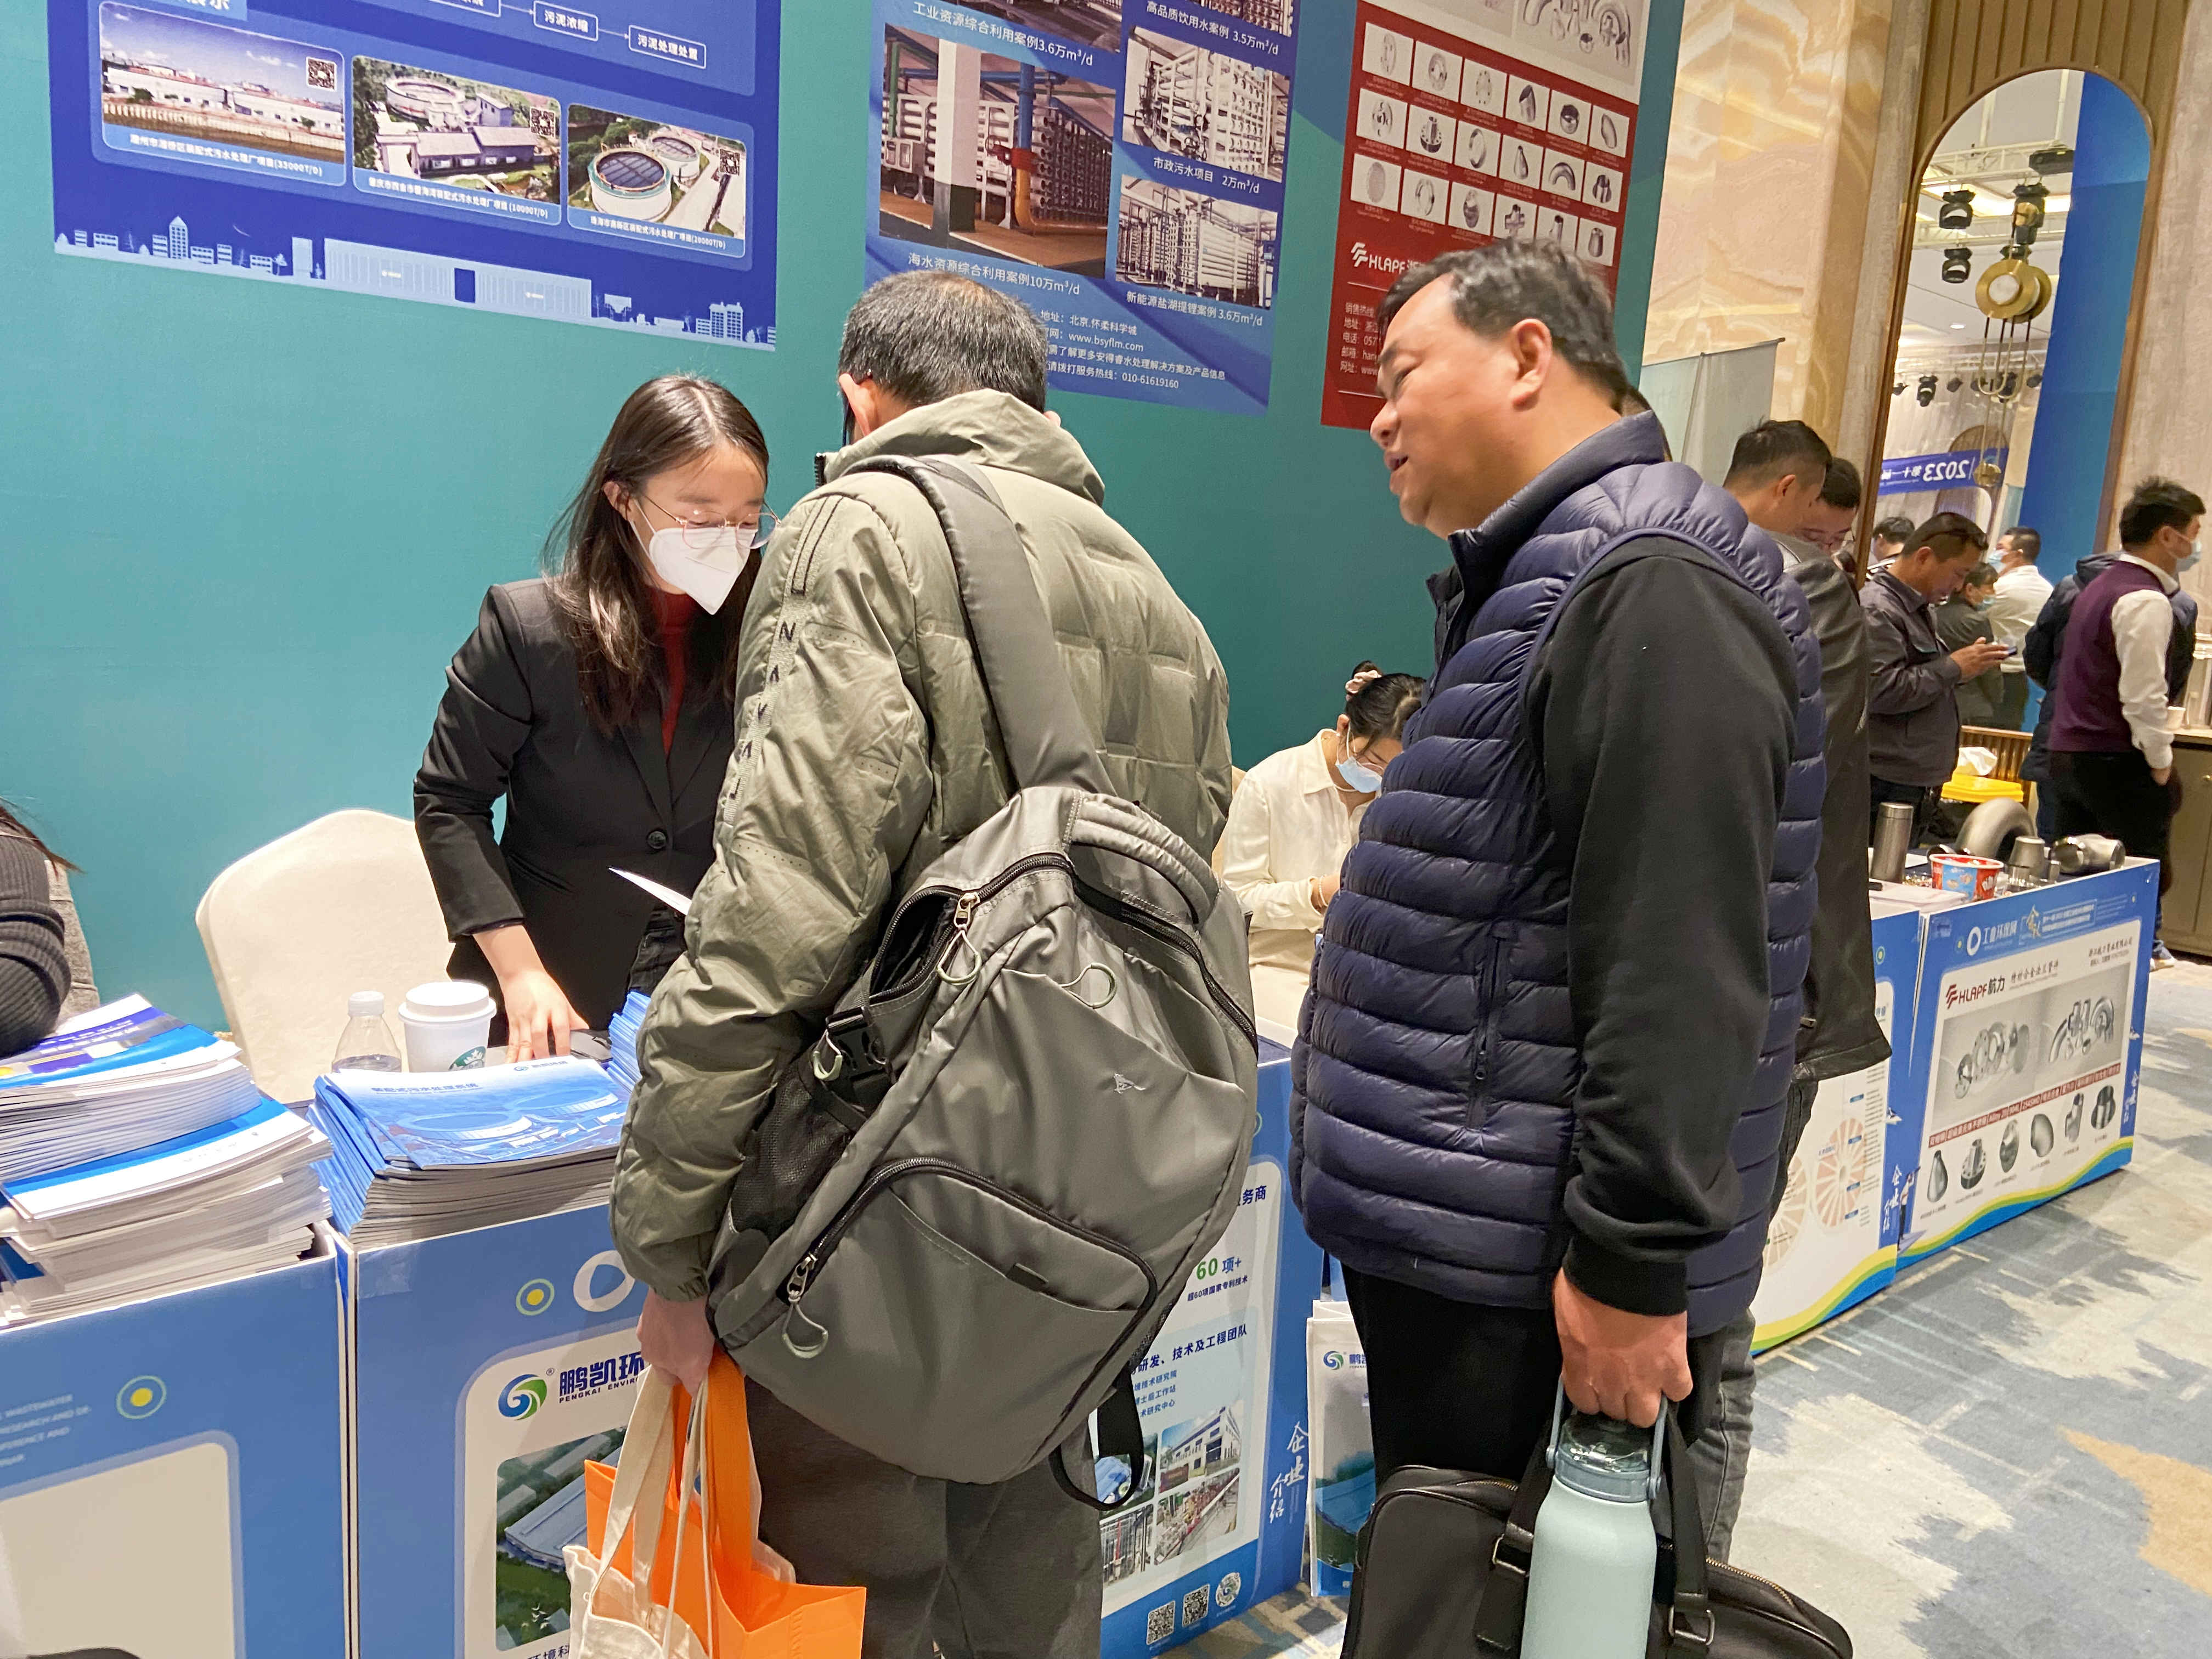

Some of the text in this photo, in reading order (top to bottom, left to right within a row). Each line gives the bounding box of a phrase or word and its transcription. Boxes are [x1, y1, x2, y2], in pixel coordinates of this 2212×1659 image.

[544, 9, 589, 33] 污泥浓缩
[1147, 1, 1229, 40] 高品质饮用水案例
[637, 33, 698, 61] 污泥处理处置
[1154, 157, 1213, 183] 市政污水项目
[908, 252, 1080, 295] 海水资源综合利用案例10万m³/d
[1046, 361, 1179, 388] 请拨打服务热线：010-61619160
[1959, 983, 1987, 1005] HLAPF
[1238, 1185, 1267, 1206] 务商
[1197, 1257, 1218, 1280] 60
[1132, 1323, 1247, 1375] 研发、技术及工程团队
[559, 1387, 601, 1403] PENGKAI
